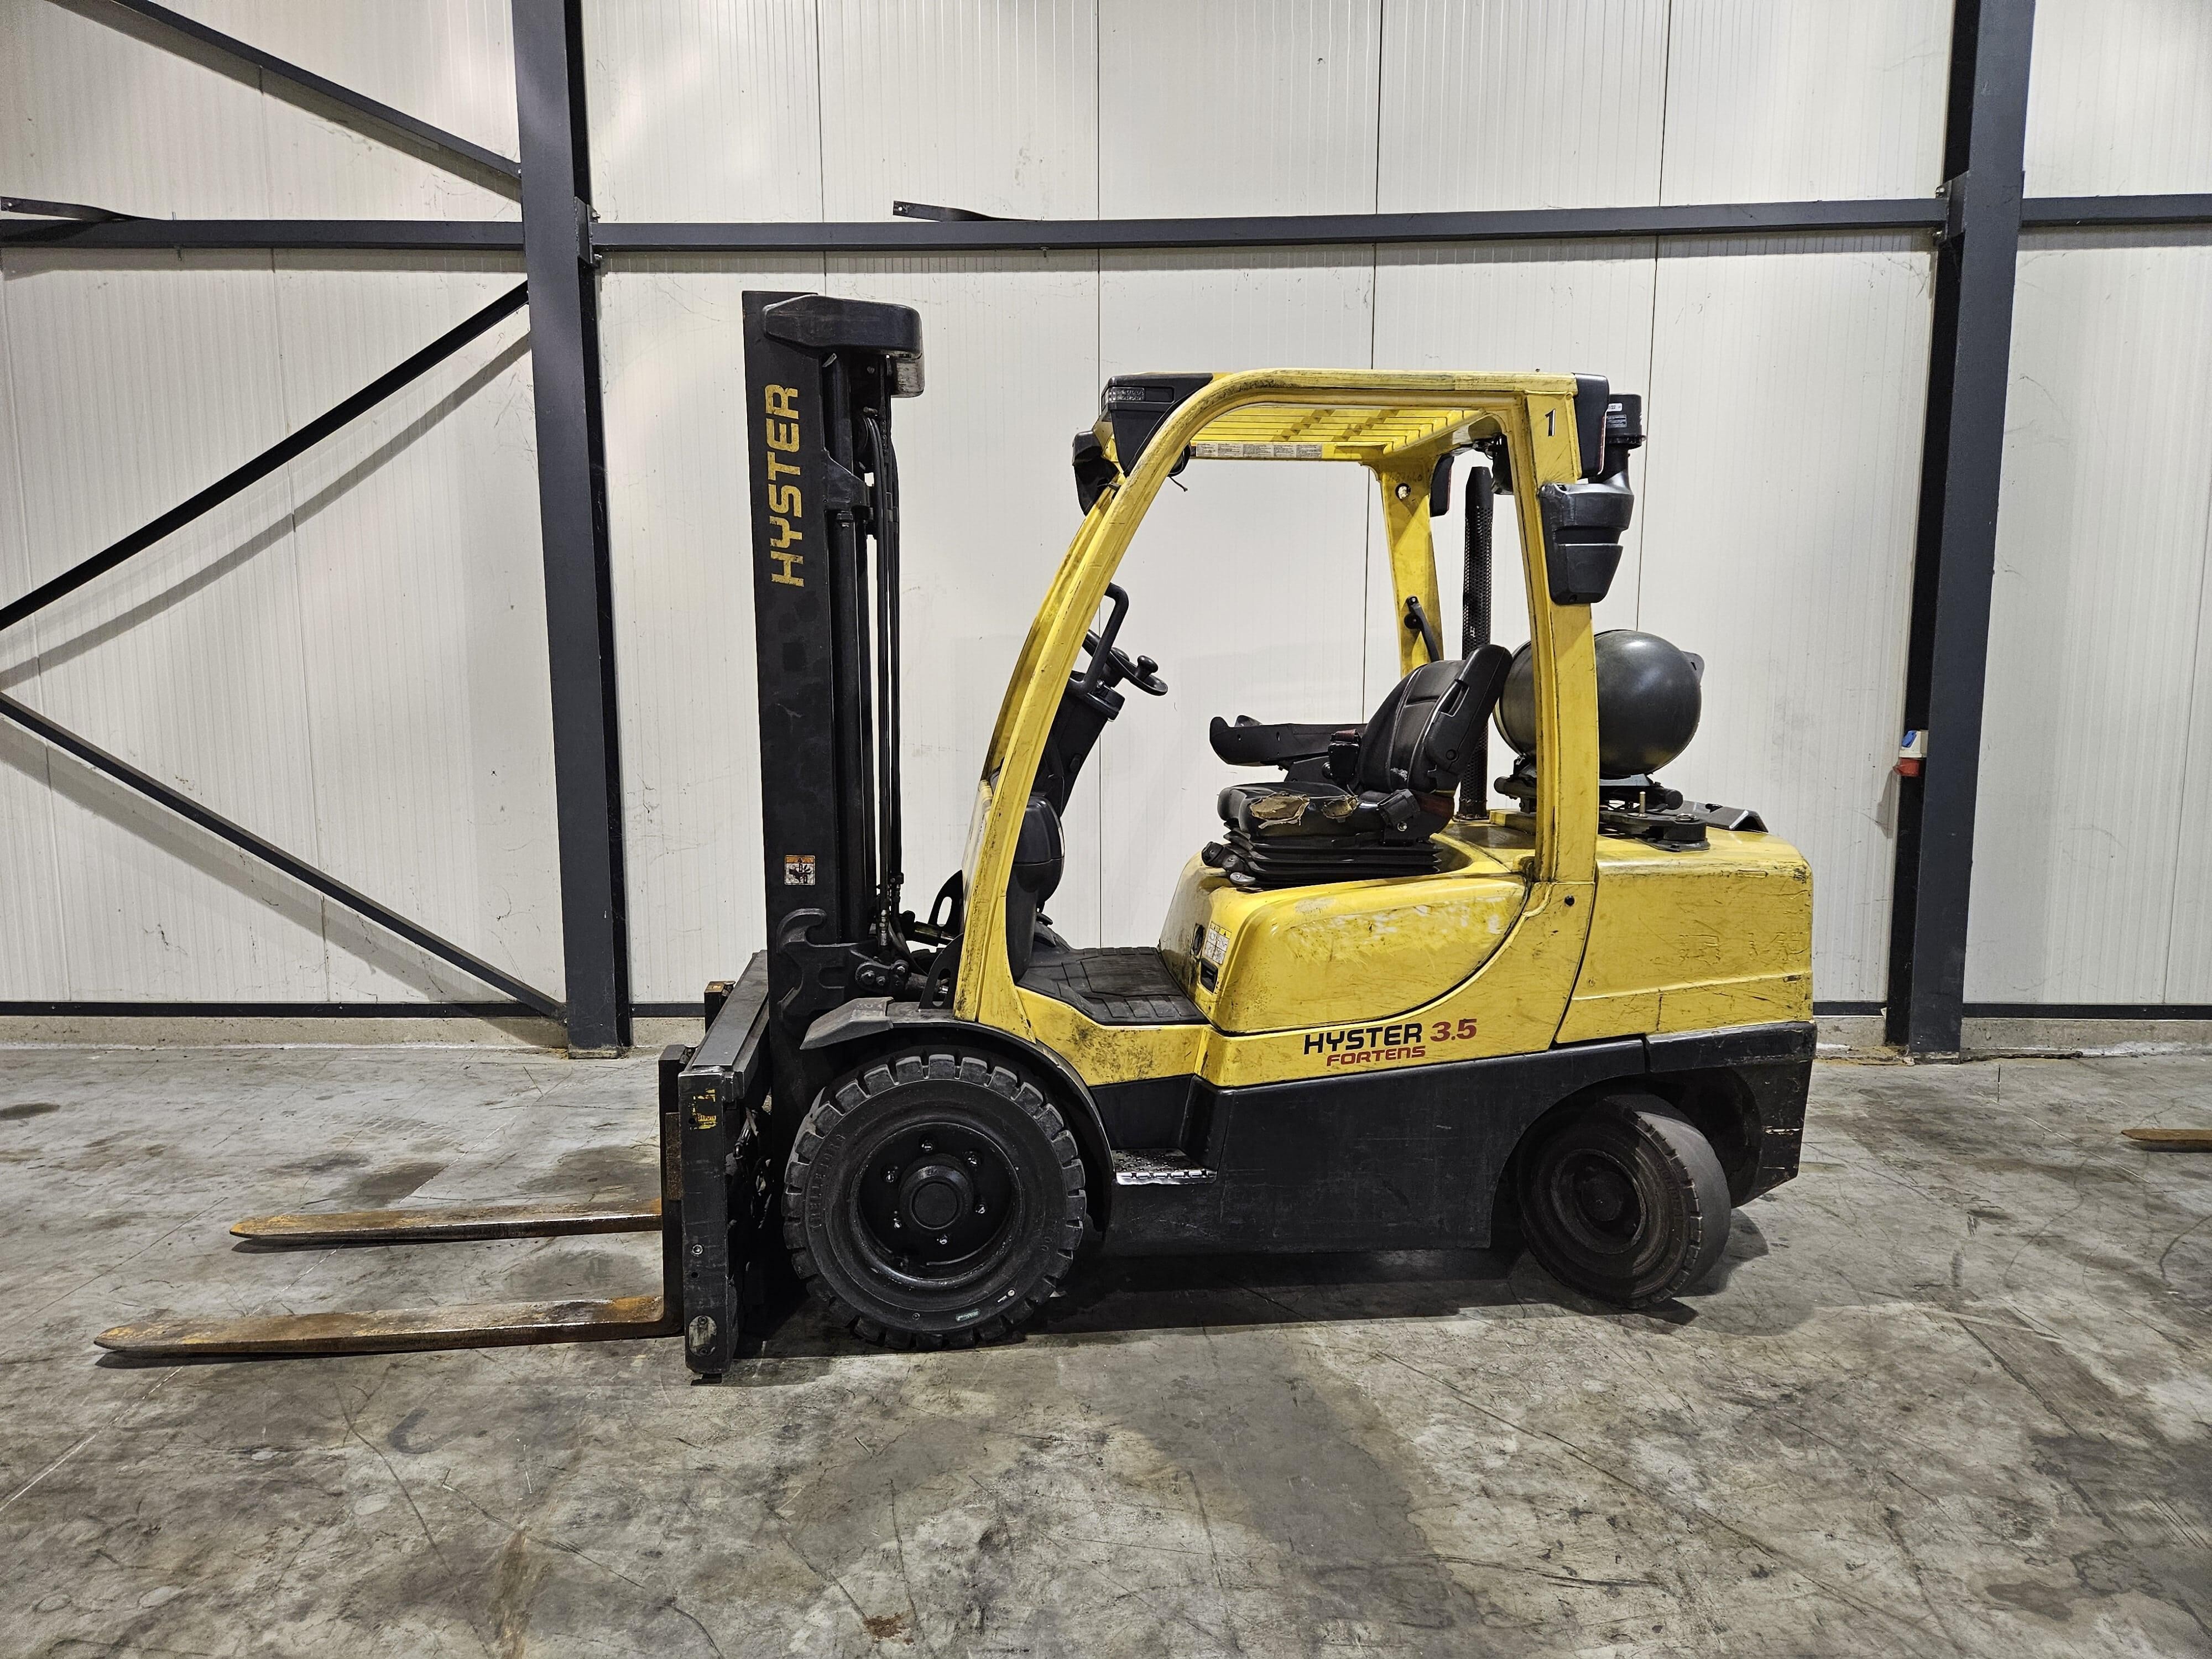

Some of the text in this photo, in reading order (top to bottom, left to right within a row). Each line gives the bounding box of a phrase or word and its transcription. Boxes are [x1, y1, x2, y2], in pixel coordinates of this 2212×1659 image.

[1545, 408, 1557, 437] 1
[764, 384, 805, 587] HYSTER
[1303, 1018, 1478, 1055] HYSTER 3.5
[1327, 1045, 1426, 1067] FORTENS
[810, 1134, 846, 1230] TRELLEBORG
